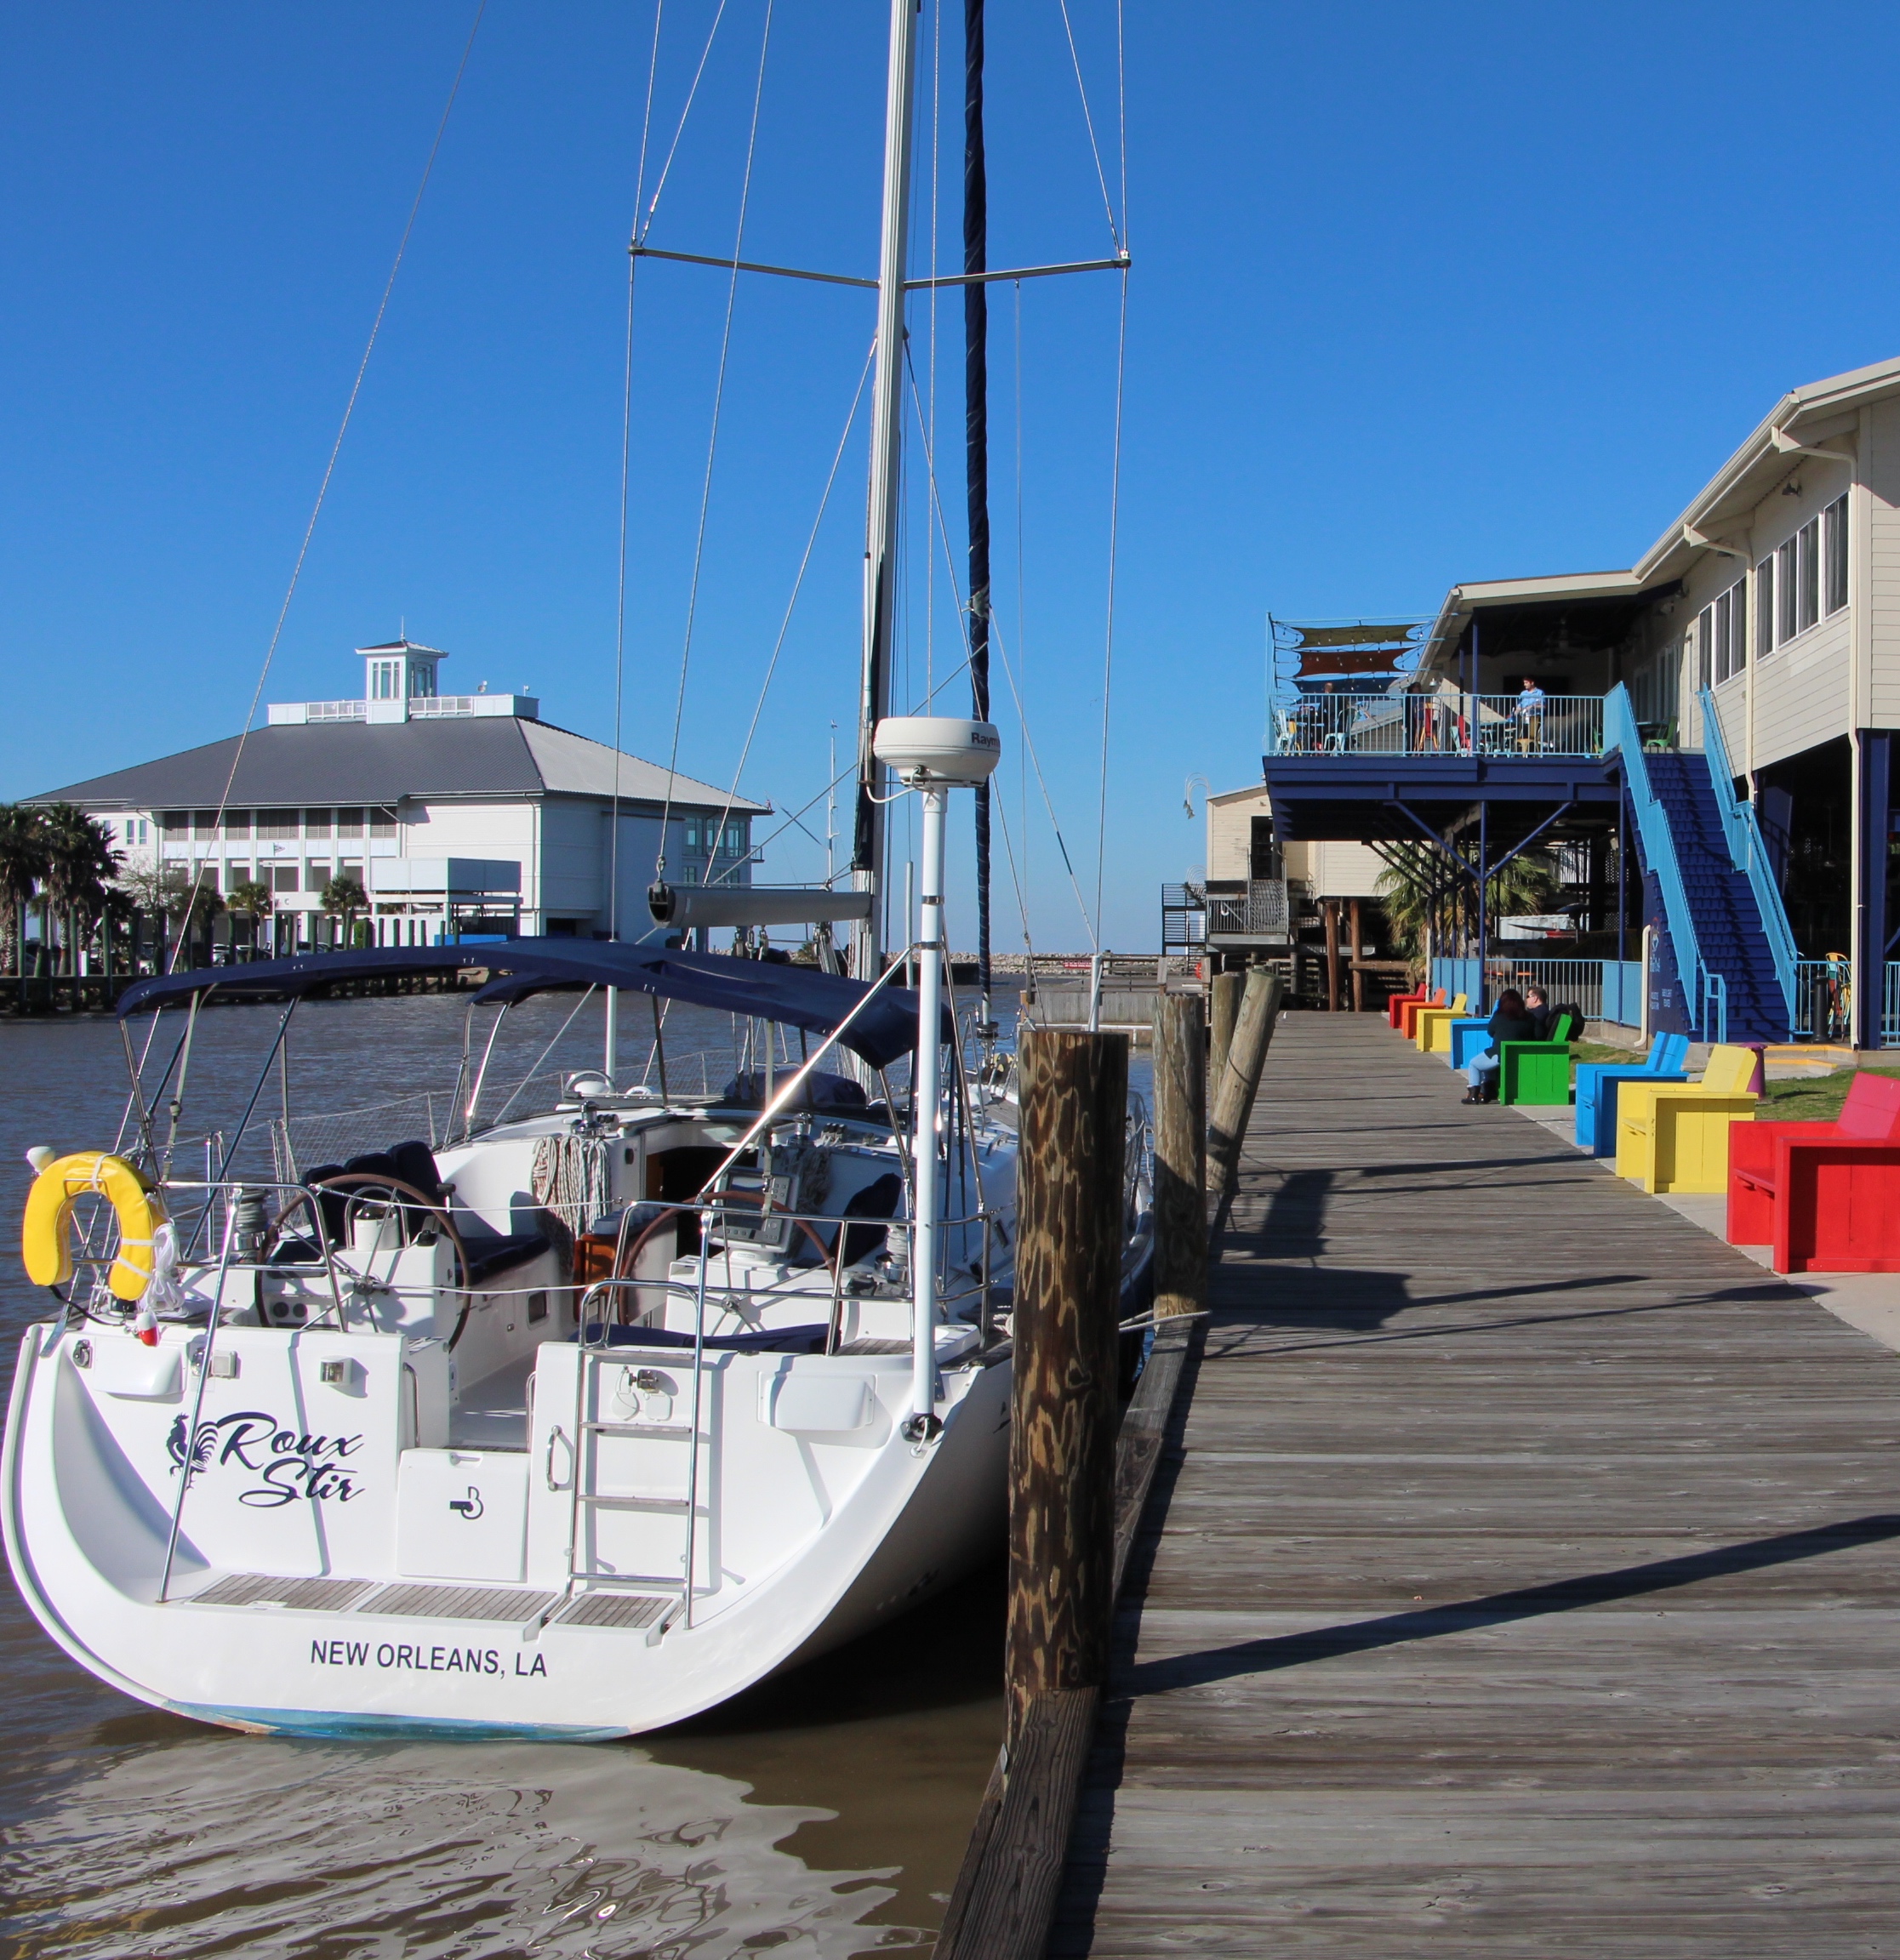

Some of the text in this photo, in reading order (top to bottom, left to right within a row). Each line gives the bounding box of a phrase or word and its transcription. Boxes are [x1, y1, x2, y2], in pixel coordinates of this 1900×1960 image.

[216, 1411, 365, 1470] Roux
[239, 1457, 366, 1507] Stir
[311, 1640, 547, 1679] NEW ORLEANS, LA
